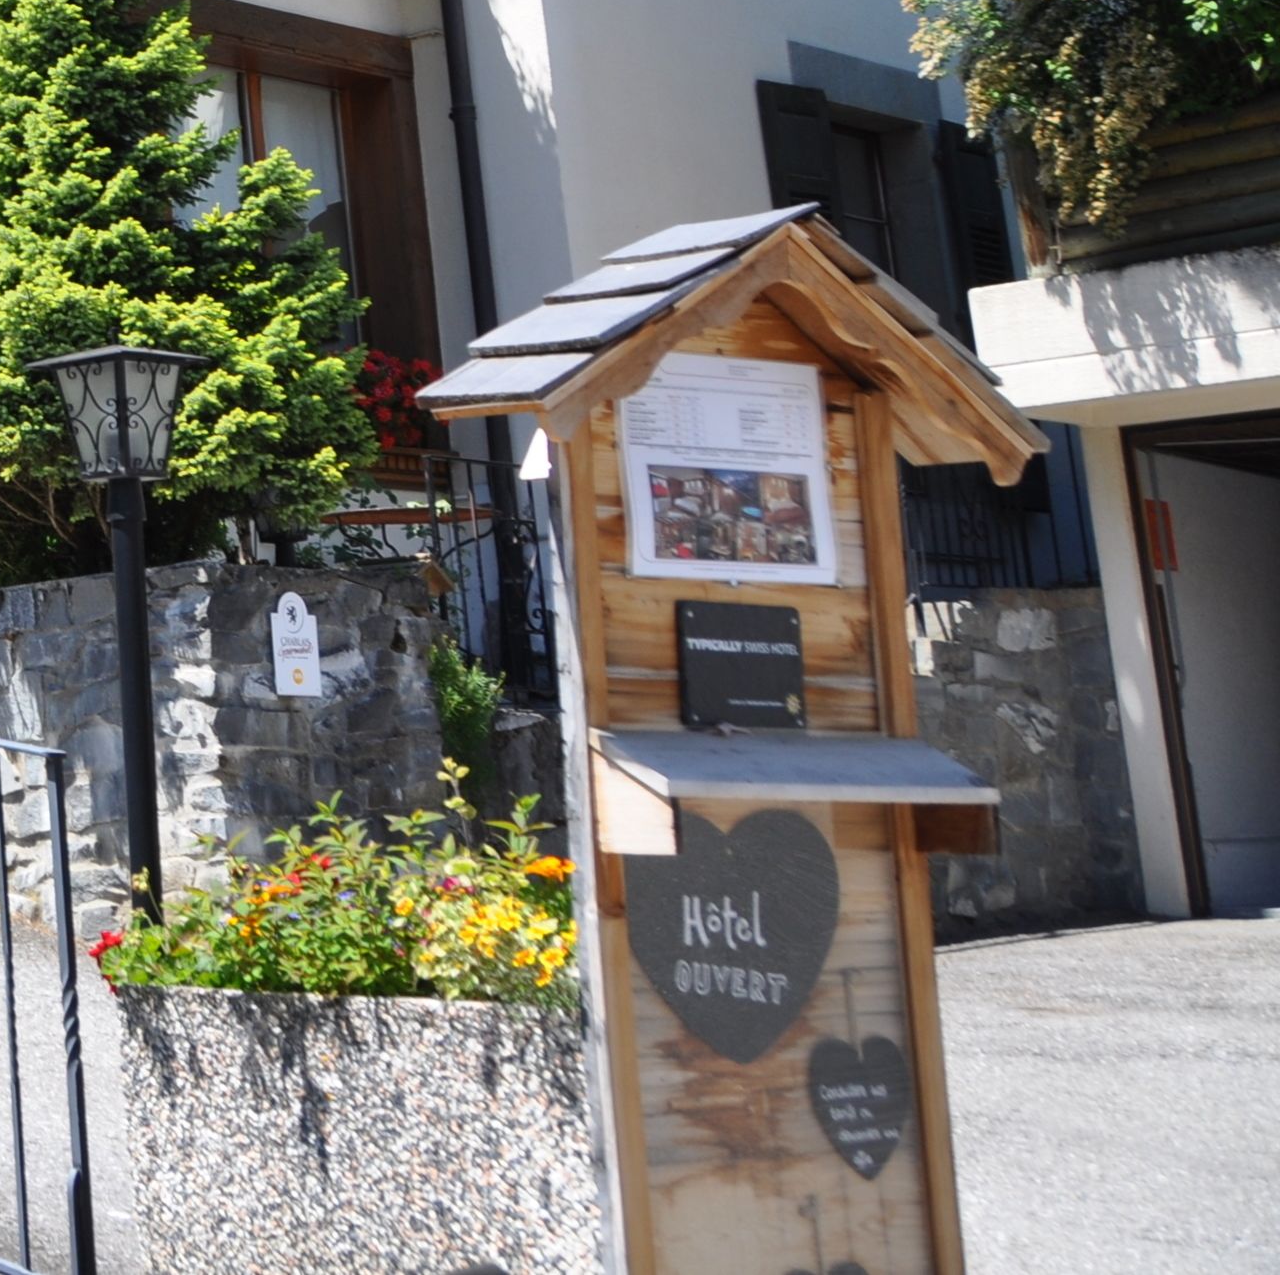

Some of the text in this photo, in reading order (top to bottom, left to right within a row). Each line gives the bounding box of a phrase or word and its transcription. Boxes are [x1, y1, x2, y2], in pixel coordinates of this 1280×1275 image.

[685, 637, 800, 656] TYPICALLY SWISS HOTEL
[681, 890, 768, 952] Hôtel
[674, 959, 790, 1006] OUVERT
